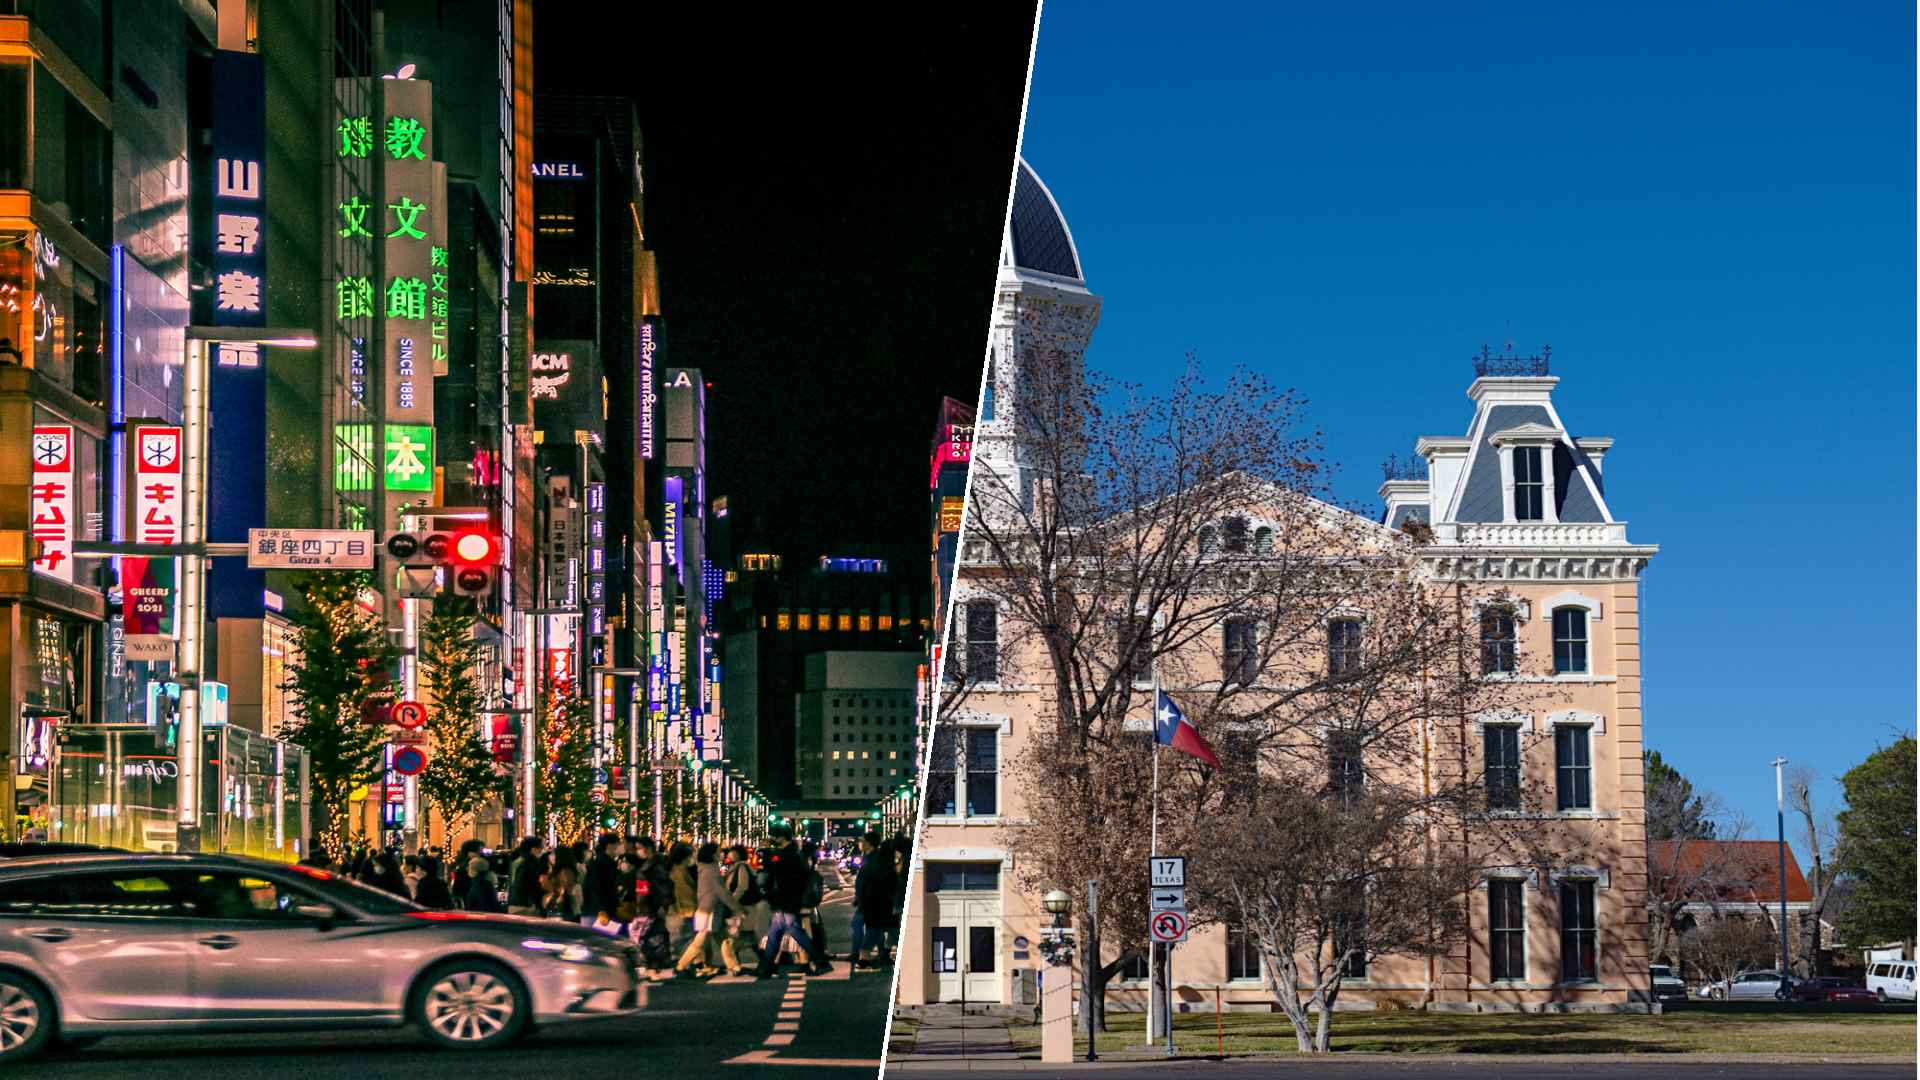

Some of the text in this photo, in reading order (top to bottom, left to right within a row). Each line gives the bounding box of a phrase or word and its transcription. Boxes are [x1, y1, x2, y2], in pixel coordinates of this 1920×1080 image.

[384, 115, 428, 320] 教文館
[400, 337, 414, 408] SINCE 1885
[386, 436, 426, 480] 本
[258, 530, 292, 538] 中央区
[258, 539, 365, 555] 銀座四丁目
[289, 555, 332, 564] Ginza 4
[130, 587, 169, 596] CHEERS
[137, 604, 163, 612] 2021
[134, 643, 168, 651] WAKO
[1159, 862, 1175, 874] 17
